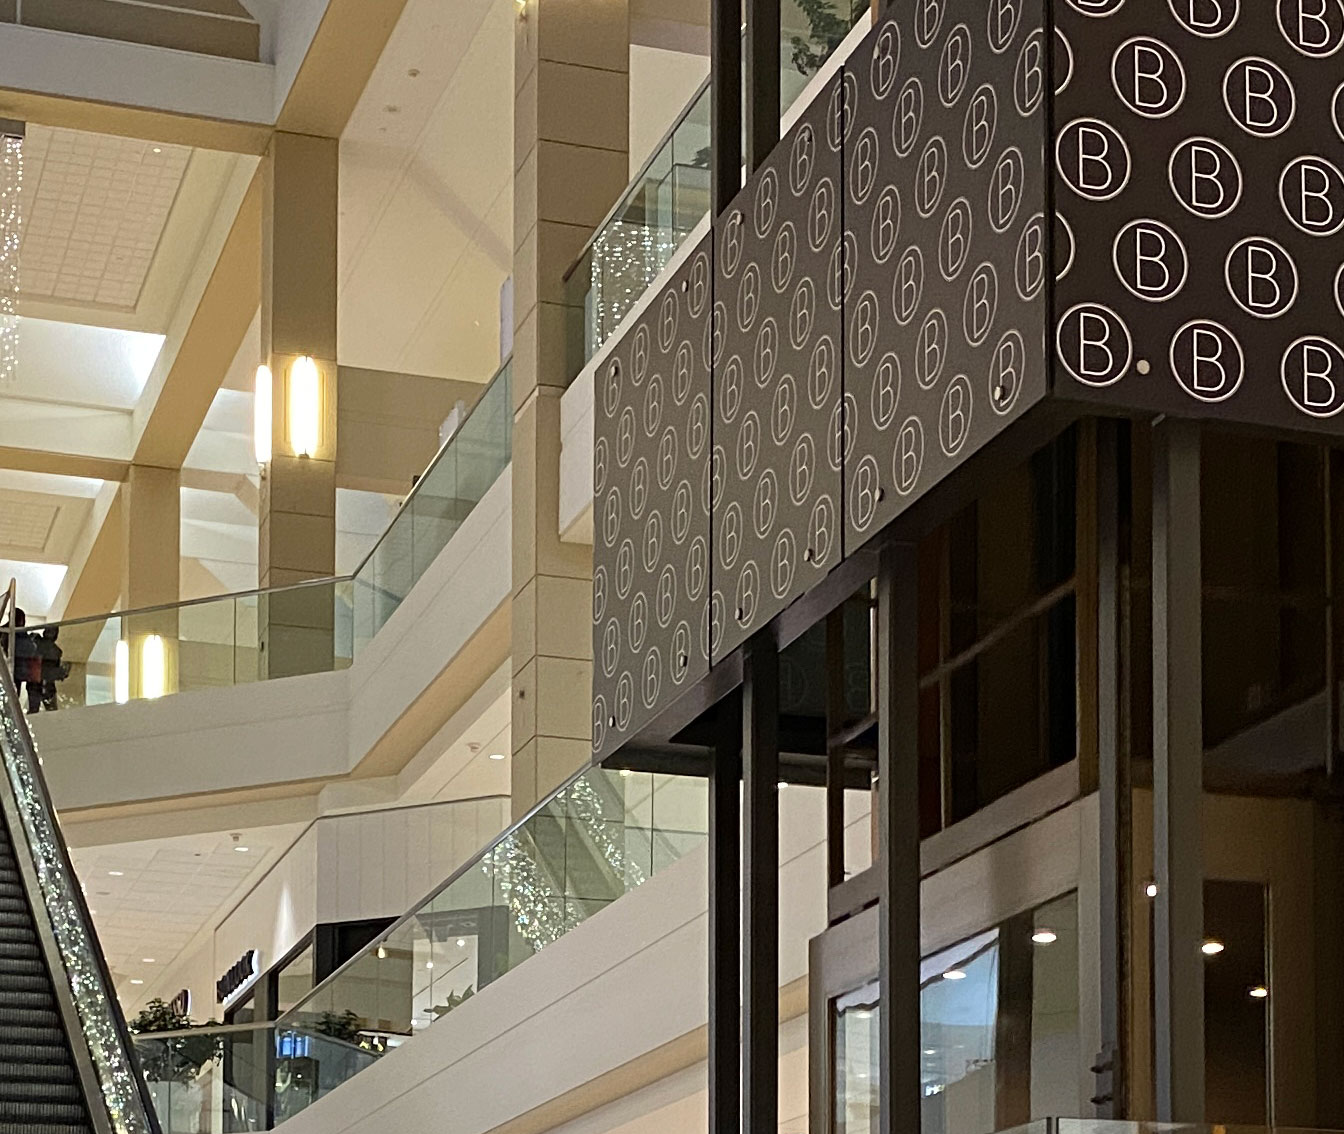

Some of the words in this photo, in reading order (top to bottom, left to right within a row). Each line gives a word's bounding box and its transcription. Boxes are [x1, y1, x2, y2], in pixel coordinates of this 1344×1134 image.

[879, 30, 894, 95] B
[947, 32, 964, 101] B
[1024, 35, 1042, 108] B
[1133, 44, 1168, 109] B
[837, 81, 851, 143] B
[901, 86, 916, 152] B
[972, 92, 989, 162] B
[1244, 64, 1278, 128] B
[858, 136, 872, 200] B
[924, 145, 940, 212] B
[998, 155, 1015, 226] B
[1077, 126, 1112, 192] B
[1189, 145, 1224, 210] B
[879, 194, 894, 259] B
[1299, 163, 1333, 227] B
[837, 240, 851, 303] B
[948, 207, 964, 275] B
[1025, 220, 1043, 292] B
[1134, 227, 1169, 293] B
[901, 255, 916, 320] B
[973, 271, 989, 340] B
[1245, 245, 1280, 309] B
[857, 299, 872, 363] B
[924, 317, 940, 384] B
[1078, 311, 1113, 377] B
[1191, 328, 1226, 393] B
[879, 361, 894, 425] B
[999, 338, 1016, 408] B
[1301, 344, 1335, 408] B
[837, 401, 850, 464] B
[948, 383, 964, 451] B
[901, 425, 916, 490] B
[857, 464, 872, 527] B
